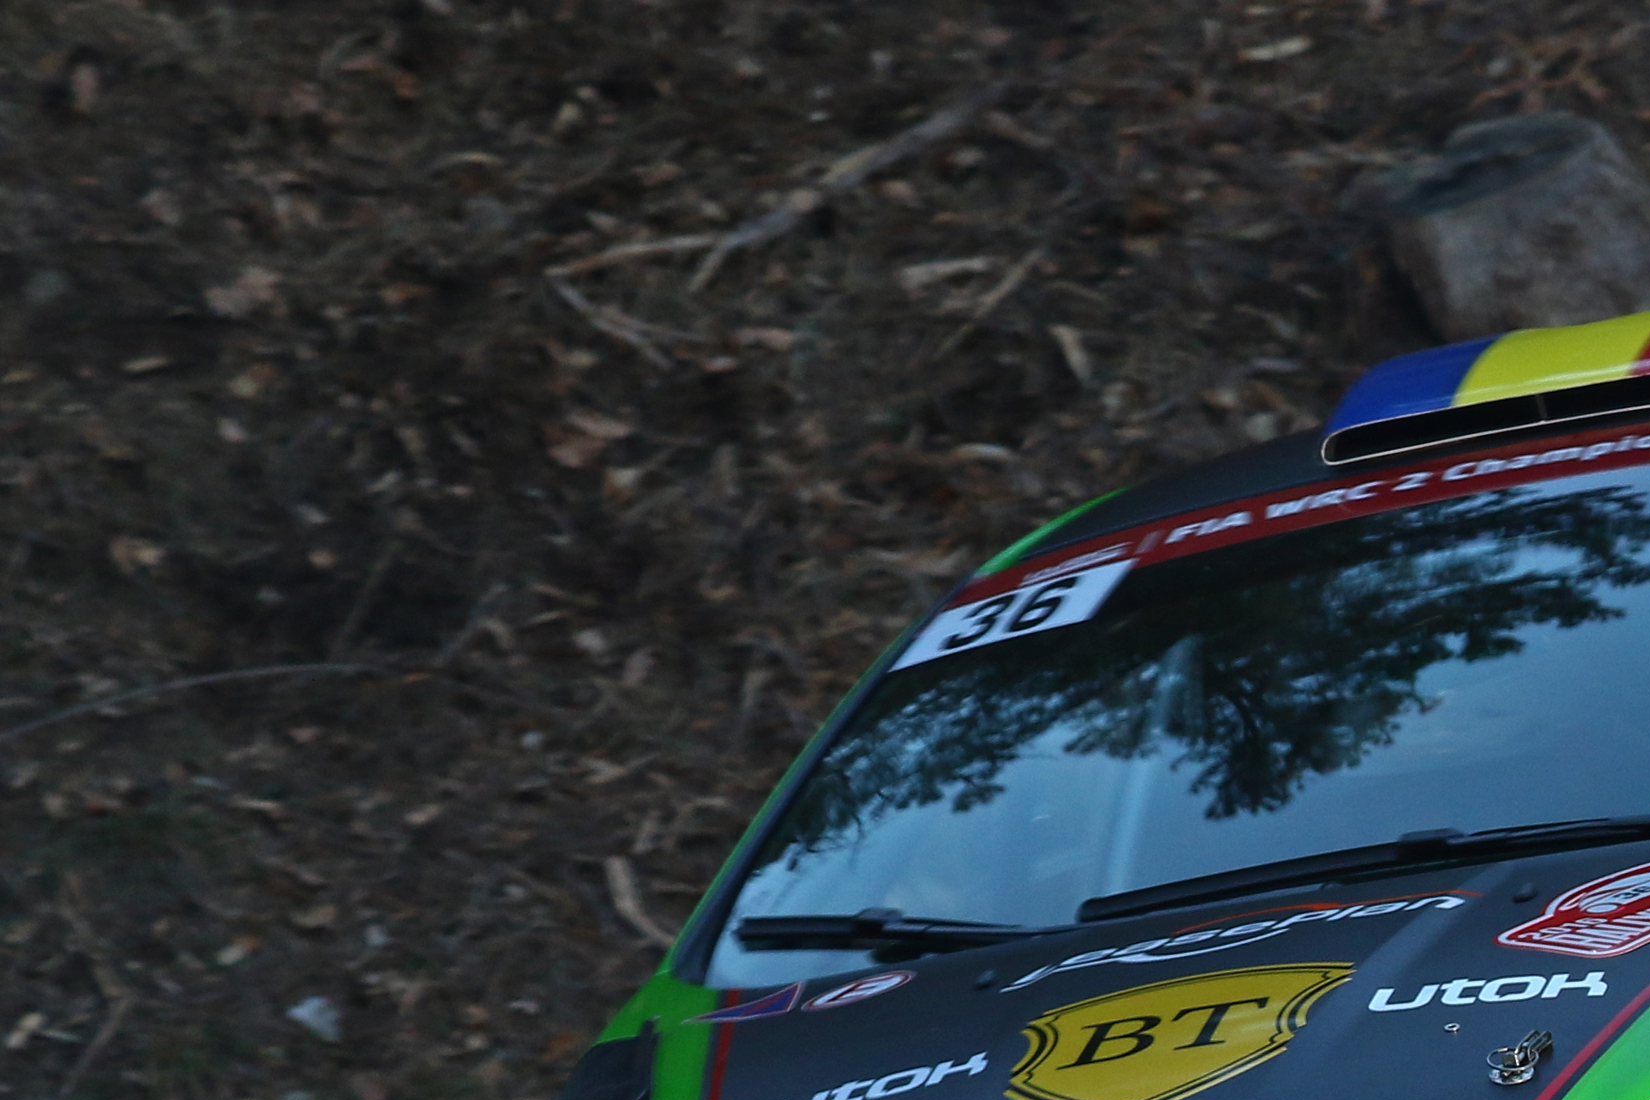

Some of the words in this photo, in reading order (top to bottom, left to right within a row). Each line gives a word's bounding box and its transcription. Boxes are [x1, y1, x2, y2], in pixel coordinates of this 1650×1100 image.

[1165, 511, 1251, 544] FIA
[1266, 480, 1384, 519] WRC
[1391, 471, 1433, 491] 2
[940, 577, 1080, 650] 36
[1057, 997, 1268, 1071] BT
